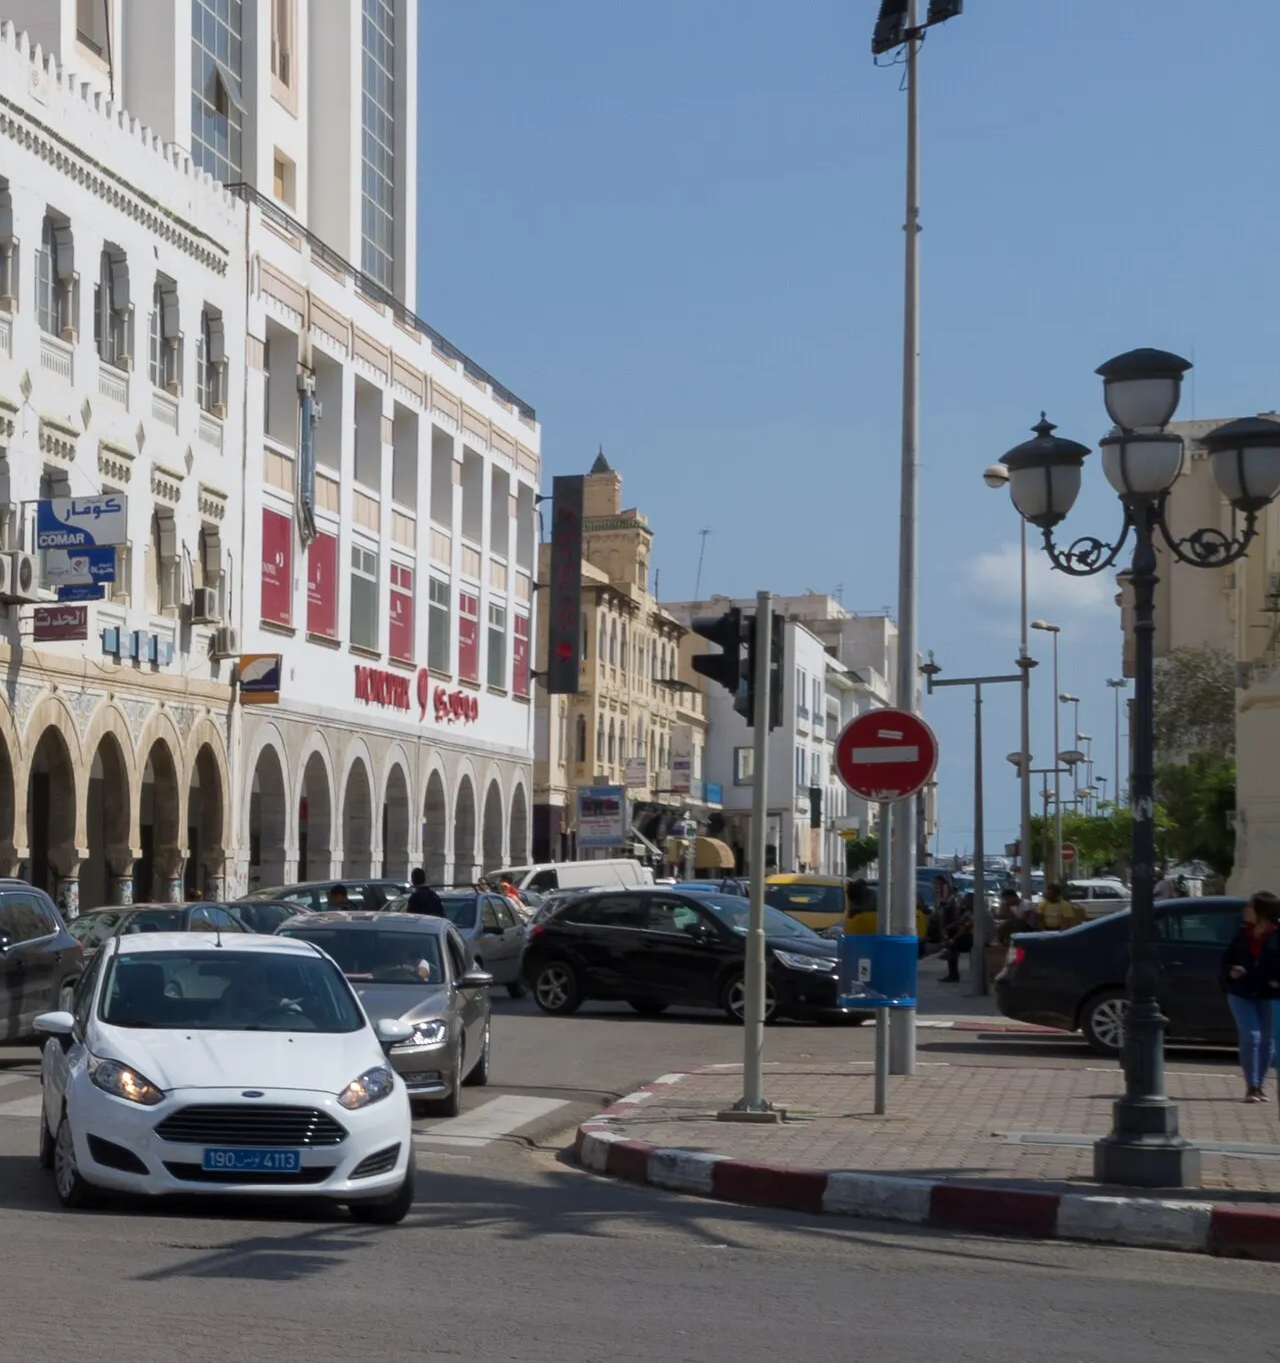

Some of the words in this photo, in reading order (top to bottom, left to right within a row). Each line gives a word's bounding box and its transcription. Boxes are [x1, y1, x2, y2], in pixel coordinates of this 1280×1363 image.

[64, 498, 122, 521] كومار
[39, 533, 85, 547] COMAR
[35, 608, 85, 627] الحدث
[209, 1150, 235, 1167] 190
[235, 1151, 260, 1167] تونس
[263, 1152, 297, 1168] 4113
